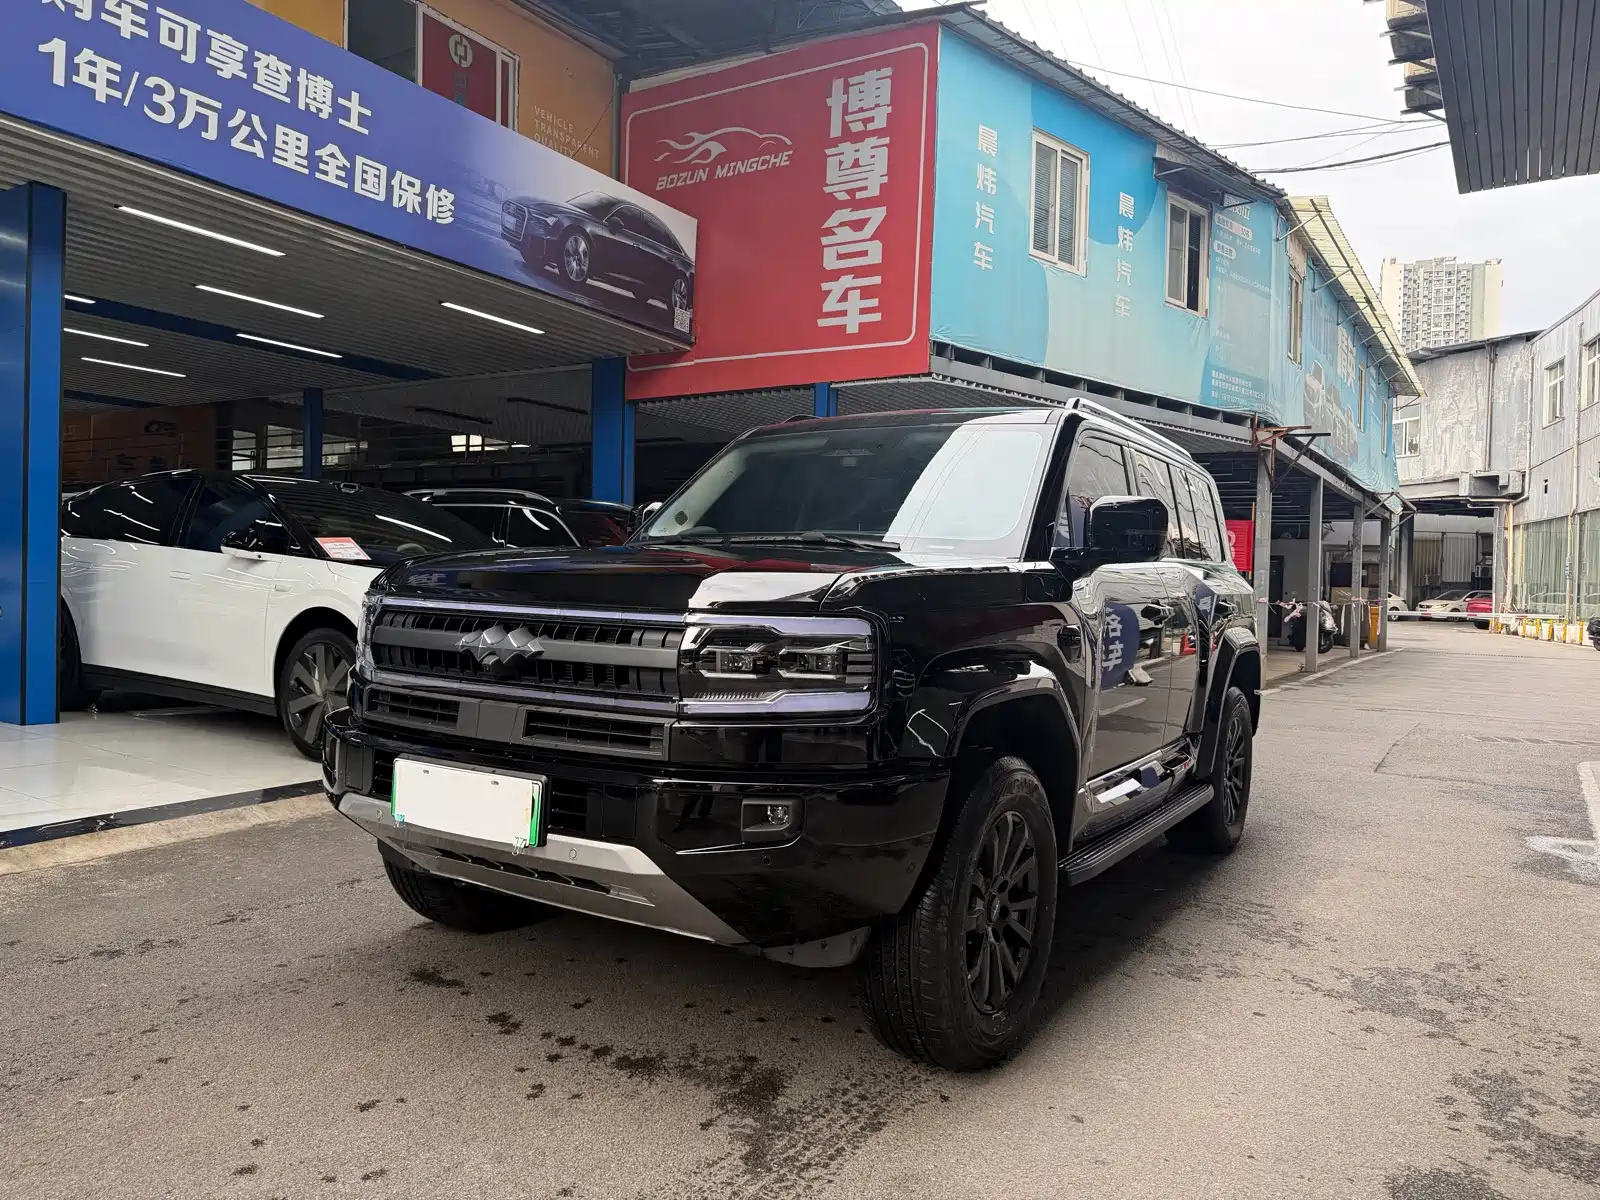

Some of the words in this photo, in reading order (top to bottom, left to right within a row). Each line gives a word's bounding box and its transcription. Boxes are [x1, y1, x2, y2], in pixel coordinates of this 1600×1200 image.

[37, 36, 456, 225] 1年/3万公里全国保修
[534, 105, 574, 132] VEHICLE
[714, 150, 794, 181] MINGCHE
[816, 66, 894, 335] 博尊名车
